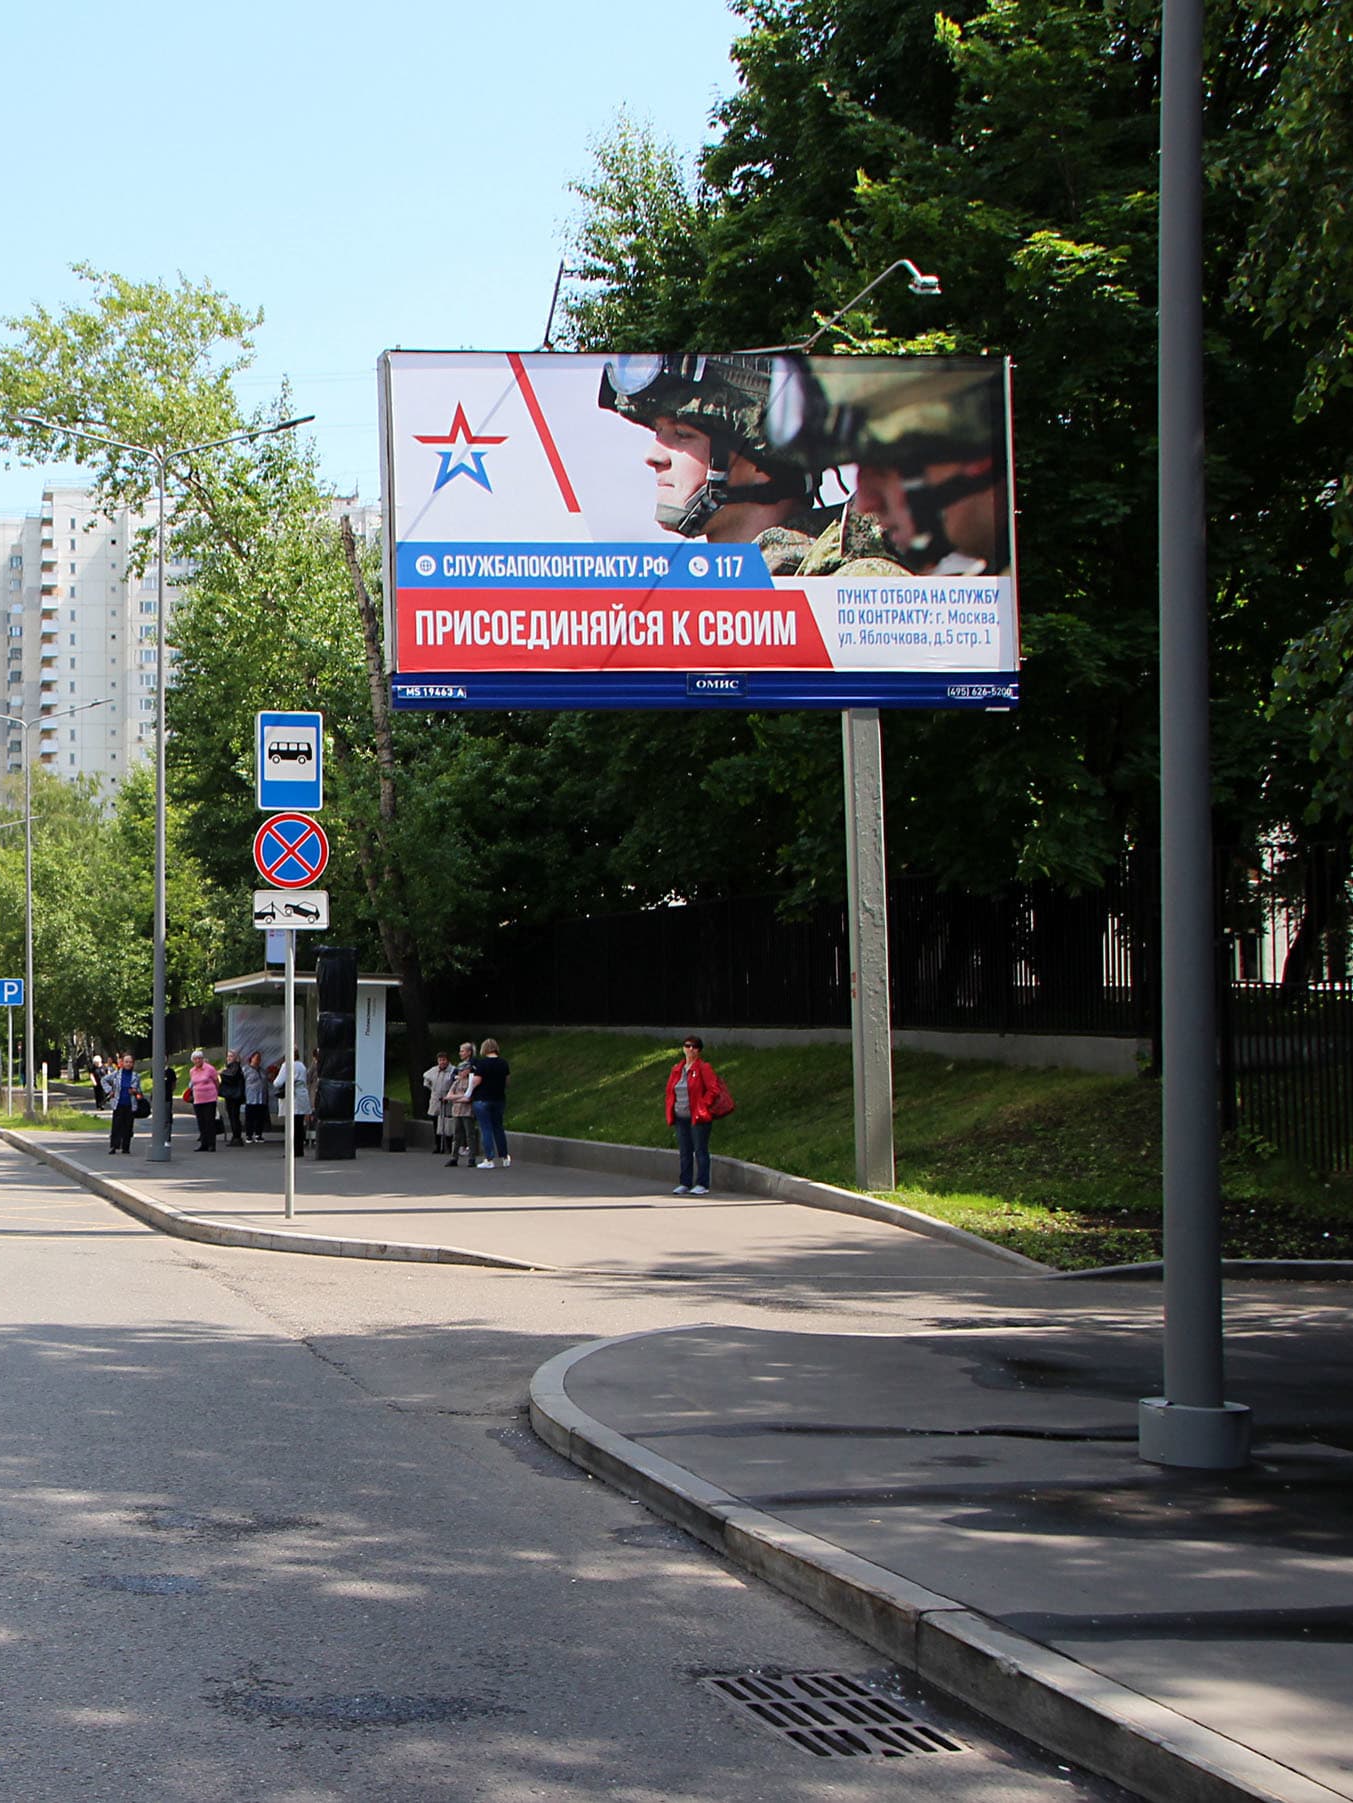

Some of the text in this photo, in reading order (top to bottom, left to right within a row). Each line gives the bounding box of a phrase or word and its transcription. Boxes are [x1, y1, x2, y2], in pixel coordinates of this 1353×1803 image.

[443, 555, 669, 577] СЛУЖБАПОКОНТРАКТУ.РФ
[715, 556, 744, 578] 117
[837, 588, 1000, 604] ПУНКТ ОТБОРА НА СЛУЖБУ
[415, 603, 797, 650] ПРИСОЕДИНЯЙСЯ К СВОИМ
[838, 609, 1000, 627] ПО КОНТРАКТУ: г. Москва,
[838, 631, 857, 648] ул.
[956, 631, 982, 648] стр.
[985, 629, 992, 645] 1
[406, 687, 464, 697] MS 19463 A
[947, 687, 1012, 697] (495) 626-5200
[3, 982, 19, 1002] P
